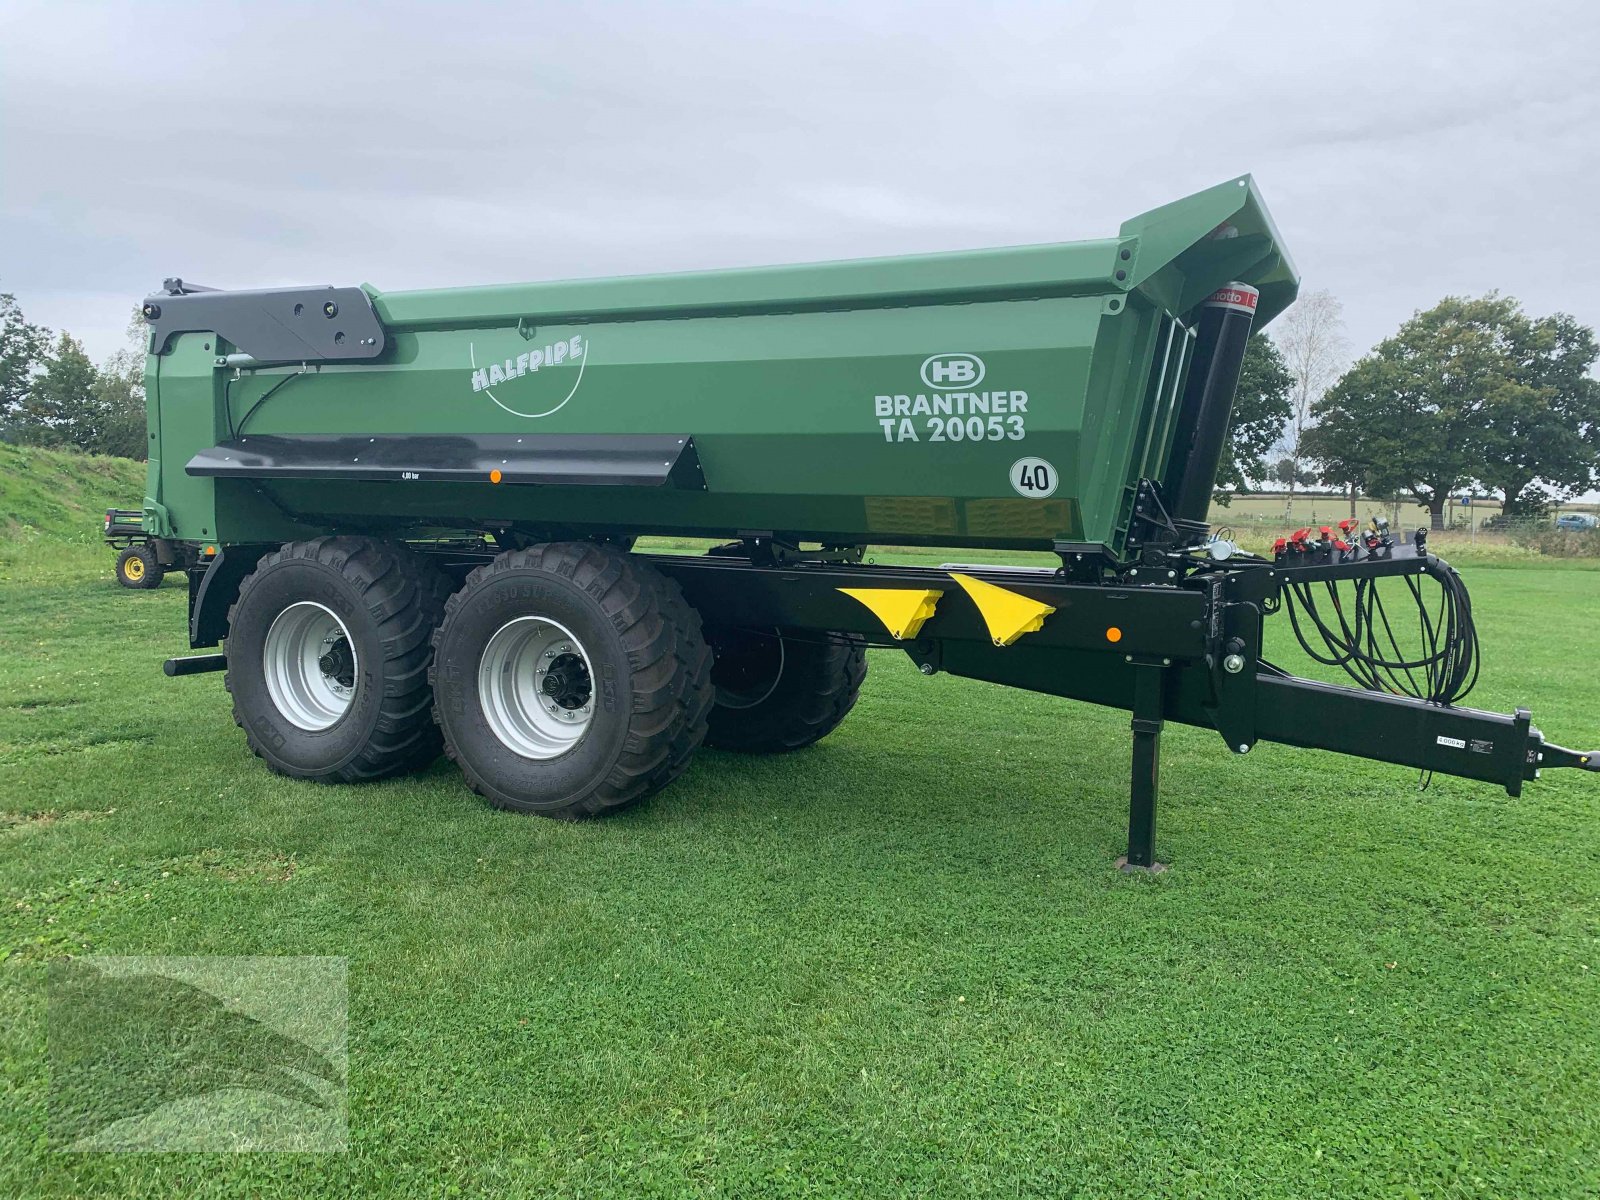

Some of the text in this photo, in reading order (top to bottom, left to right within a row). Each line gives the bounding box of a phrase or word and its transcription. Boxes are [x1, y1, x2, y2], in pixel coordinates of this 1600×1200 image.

[471, 335, 583, 392] HALFPIPE
[932, 360, 976, 382] HB
[874, 390, 1029, 416] BRANTNER
[879, 415, 1026, 443] TA 20053
[411, 472, 420, 480] bar
[1020, 465, 1050, 491] 40
